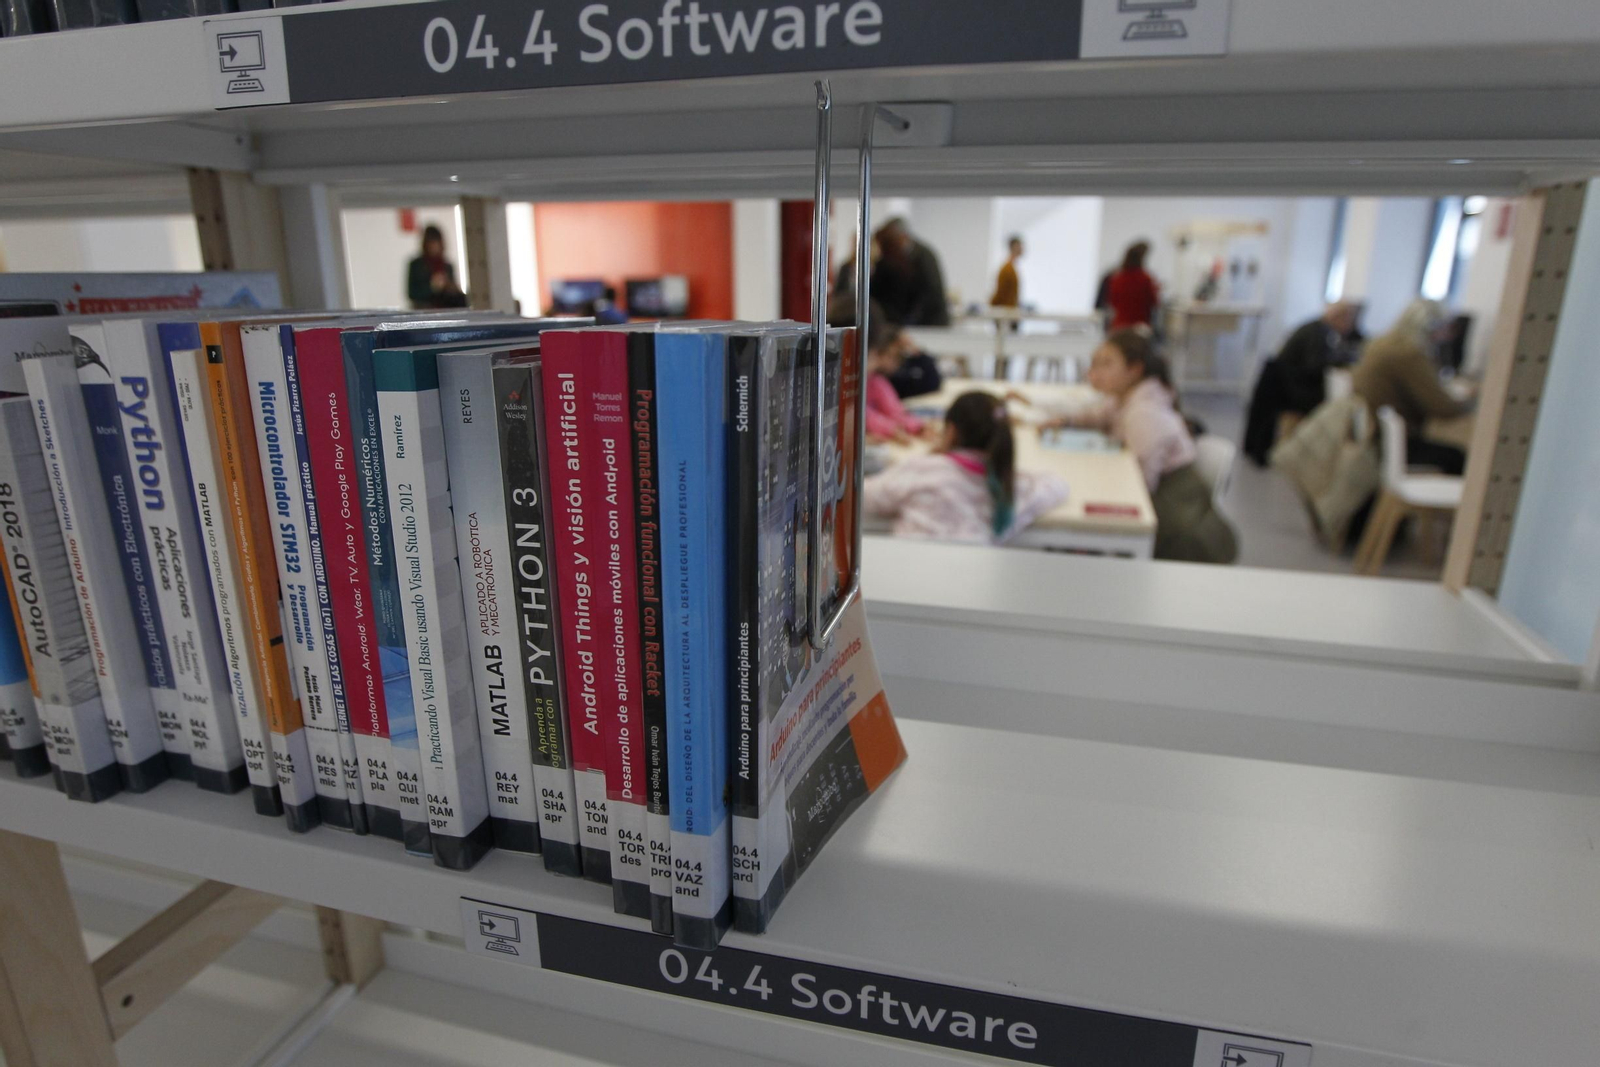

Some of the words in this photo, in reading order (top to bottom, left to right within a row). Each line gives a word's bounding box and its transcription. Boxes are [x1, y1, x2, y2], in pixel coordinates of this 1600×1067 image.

[423, 9, 559, 73] 04.4
[578, 0, 884, 63] Software
[287, 355, 296, 382] Peláez
[290, 383, 301, 413] Pizarro
[460, 388, 473, 424] REYES
[503, 403, 528, 411] Addison
[592, 392, 623, 401] Manuel
[595, 403, 621, 412] Torres
[736, 375, 749, 433] Schernich
[37, 399, 55, 450] Sketches
[295, 413, 304, 436] Jesús
[328, 392, 342, 440] Games
[505, 412, 527, 421] Wesley
[557, 373, 581, 471] artificial
[593, 413, 623, 423] Remon
[120, 374, 166, 512] Python
[221, 415, 233, 451] ejercicios
[370, 437, 378, 449] EN
[393, 414, 406, 460] Ramírez
[334, 443, 345, 470] Play
[633, 389, 657, 517] Programación
[257, 381, 291, 518] Microcontrolador
[279, 523, 301, 574] STM32
[301, 461, 316, 499] práctico
[361, 437, 377, 508] Numéricos
[372, 449, 385, 506] APLICACIONES
[602, 438, 619, 505] Android
[53, 463, 73, 531] Introducción
[198, 482, 213, 527] MATLAB
[231, 481, 241, 507] Python
[338, 473, 350, 519] Google
[398, 483, 415, 514] 2012
[512, 487, 538, 507] 3
[678, 460, 688, 538] PROFESIONAL
[0, 482, 24, 538] 2018
[113, 474, 139, 554] Electrónica
[306, 500, 318, 535] Manual
[378, 505, 387, 524] CON
[565, 478, 586, 545] visión
[207, 529, 216, 547] con
[345, 522, 355, 531] y
[368, 511, 383, 566] Métodos
[401, 514, 420, 554] Studio
[608, 510, 620, 539] con
[346, 534, 357, 564] Auto
[468, 512, 484, 570] ROBÓTICA
[131, 557, 144, 582] con
[149, 526, 172, 592] prácticas
[166, 527, 192, 619] Aplicaciones
[310, 538, 326, 583] ARDUINO.
[573, 552, 590, 566] y
[640, 521, 659, 603] funcional
[210, 549, 231, 616] programados
[406, 556, 423, 592] Visual
[608, 543, 623, 604] móviles
[679, 543, 690, 609] DESPLIEGUE
[80, 585, 90, 600] de
[318, 584, 329, 604] CON
[482, 549, 500, 629] MECATRÓNICA
[297, 584, 315, 652] Programación
[411, 594, 428, 635] usando
[475, 581, 490, 636] APLICADO
[514, 523, 554, 686] PYTHON
[574, 572, 592, 644] Things
[289, 594, 304, 645] Desarrollo
[321, 608, 335, 630] (IoT)
[643, 608, 657, 638] con
[681, 613, 690, 626] AL
[84, 602, 107, 677] Programación
[224, 616, 240, 671] Algoritmos
[324, 633, 339, 664] COSAS
[415, 636, 433, 667] Basic
[612, 608, 630, 702] aplicaciones
[644, 640, 662, 697] Racket
[681, 630, 691, 708] ARQUITECTURA
[737, 621, 752, 702] principiantes
[329, 664, 340, 684] LAS
[418, 668, 436, 701] Visual
[331, 683, 343, 696] DE
[483, 644, 512, 737] MATLAB
[577, 650, 599, 735] Android
[769, 712, 798, 768] Arduino
[797, 688, 815, 722] para
[814, 637, 862, 701] principiantes
[545, 699, 554, 718] con
[617, 705, 629, 723] de
[740, 704, 752, 731] para
[243, 738, 262, 748] 04.4
[425, 703, 444, 764] Practicando
[533, 706, 549, 754] Aprenda
[650, 724, 660, 748] Omar
[684, 729, 692, 742] DE
[246, 749, 265, 760] OPT
[248, 762, 263, 771] opt
[273, 752, 292, 763] 04.4
[316, 754, 335, 766] 04.4
[367, 758, 387, 769] 04.4
[618, 727, 633, 799] Desarrollo
[651, 749, 660, 766] Iván
[684, 744, 693, 781] DISEÑO
[738, 733, 750, 780] Arduino
[318, 765, 338, 777] PES
[320, 777, 337, 788] mic
[369, 769, 389, 781] PLA
[396, 771, 418, 782] 04.4
[495, 771, 518, 782] 04.4
[651, 767, 662, 790] Trejos
[371, 780, 386, 792] pla
[398, 783, 418, 794] QUI
[400, 795, 420, 805] met
[427, 794, 449, 806] 04.4
[497, 782, 520, 794] REY
[498, 794, 519, 805] mat
[542, 788, 564, 800] 04.4
[685, 785, 693, 804] DEL
[429, 805, 454, 818] RAM
[543, 800, 567, 812] SHA
[545, 812, 562, 823] apr
[584, 799, 606, 812] 04.4
[431, 818, 448, 829] apr
[587, 825, 607, 836] and
[618, 829, 643, 842] 04.4
[619, 841, 646, 855] TOR
[620, 854, 642, 866] des
[733, 845, 759, 858] 04.4
[651, 867, 672, 878] pro
[675, 858, 702, 872] 04.4
[675, 871, 704, 885] VAZ
[733, 858, 760, 871] SCH
[733, 872, 754, 883] ard
[675, 886, 700, 897] and
[658, 947, 774, 1001] 04.4
[790, 972, 1039, 1050] Software
